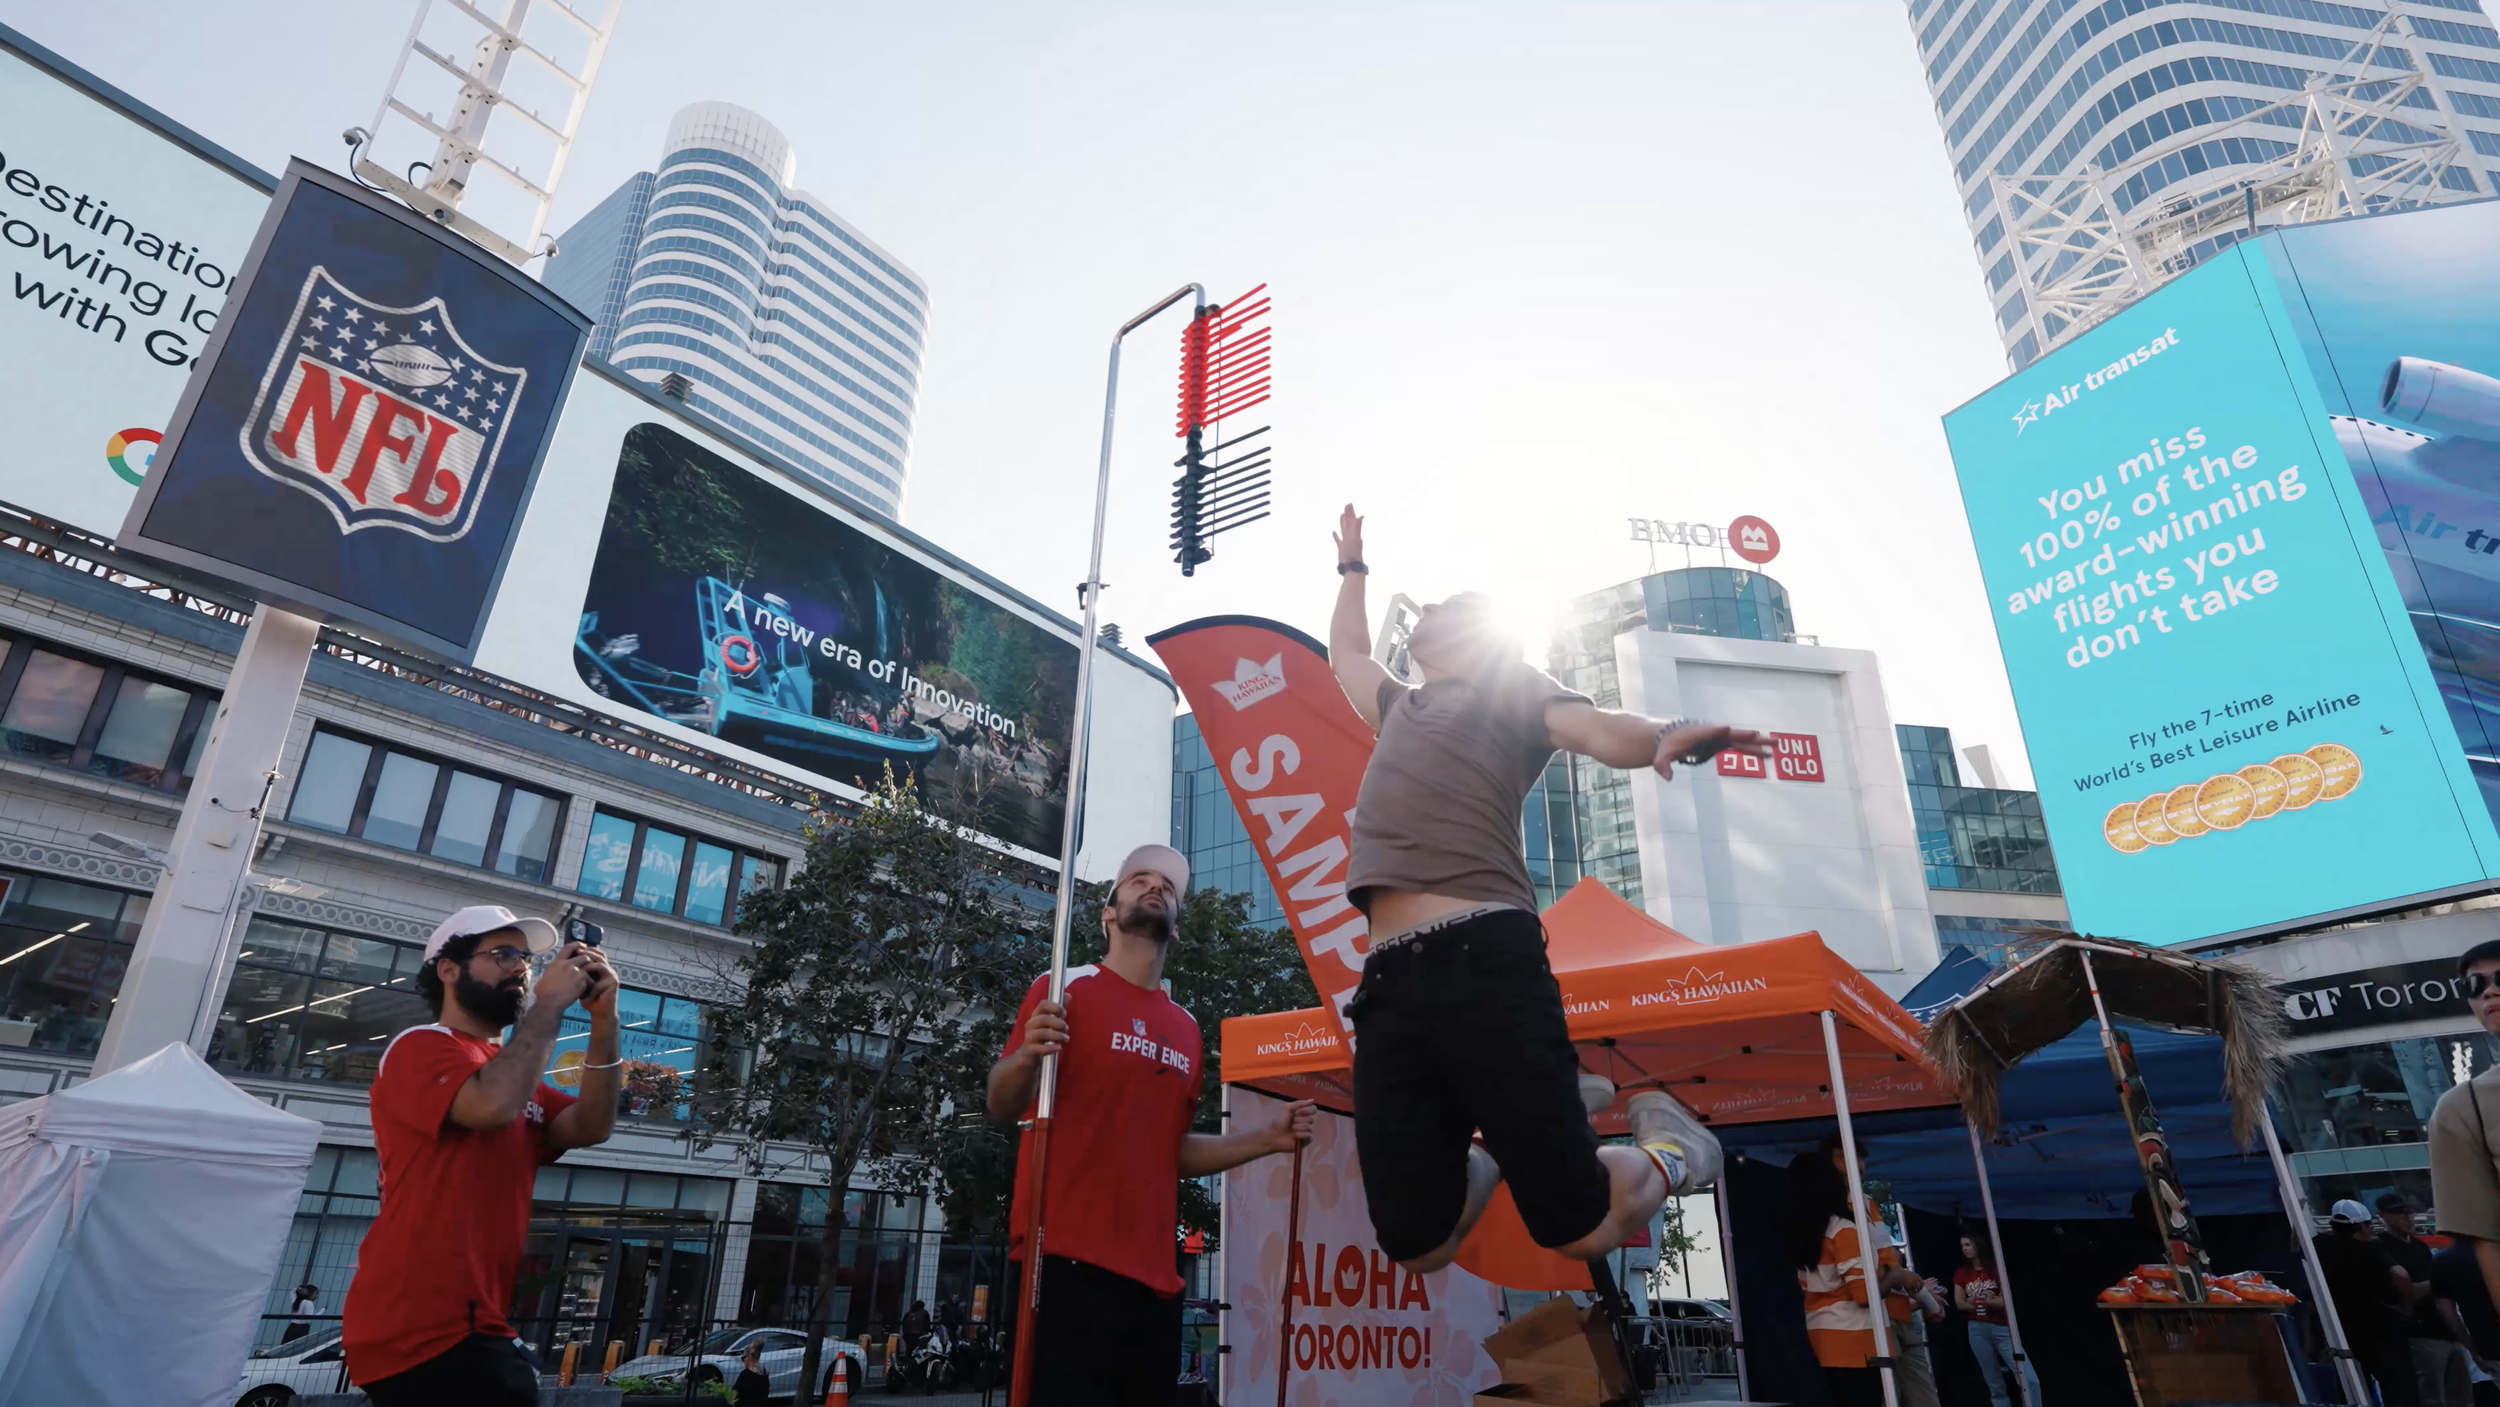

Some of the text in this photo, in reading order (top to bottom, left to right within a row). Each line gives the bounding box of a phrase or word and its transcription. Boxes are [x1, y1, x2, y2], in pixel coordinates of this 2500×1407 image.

[0, 211, 168, 317] owing
[15, 271, 200, 374] with G
[2044, 327, 2180, 416] Air transat
[271, 360, 461, 517] NFL
[2037, 426, 2207, 520] You miss
[1628, 518, 1717, 547] BMO
[2007, 465, 2307, 614] award-winning
[2019, 444, 2258, 568] 100% of the
[2371, 502, 2458, 540] Air
[2053, 527, 2266, 633] flights you
[2066, 568, 2279, 668] don't take
[724, 590, 747, 620] A
[754, 606, 815, 648] new
[820, 636, 862, 671] era
[868, 659, 896, 685] of
[901, 666, 1016, 738] Innovation
[1232, 675, 1282, 703] HAWAIIAN
[1777, 738, 1812, 756] UNI
[2073, 693, 2361, 792] World's Best Leisure Airline
[2128, 692, 2275, 750] Fly the 7-time
[1781, 757, 1818, 777] QLO
[1230, 733, 1369, 1058] SAMPL
[1631, 976, 1767, 1007] KING'S HAWAIIAN
[2284, 987, 2342, 1020] CF
[1294, 1035, 1339, 1050] HAWAII
[1281, 1240, 1431, 1311] ALOHA
